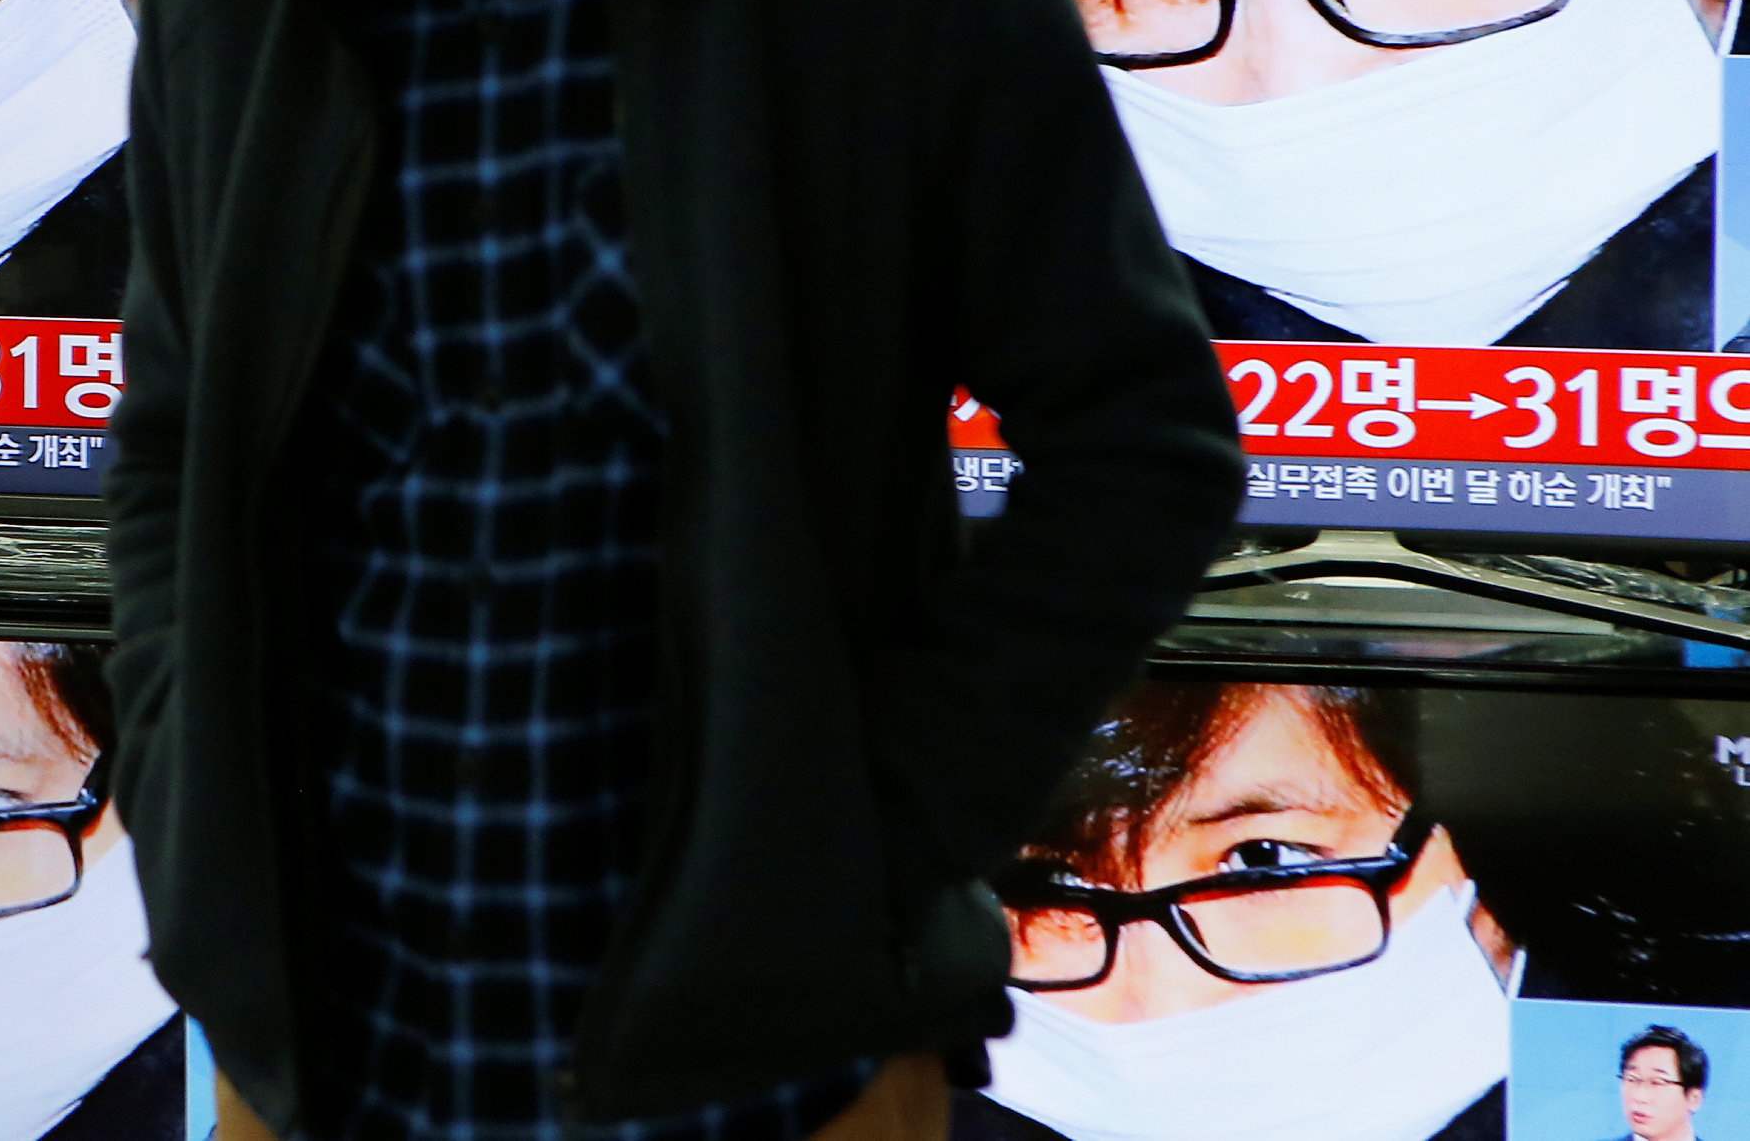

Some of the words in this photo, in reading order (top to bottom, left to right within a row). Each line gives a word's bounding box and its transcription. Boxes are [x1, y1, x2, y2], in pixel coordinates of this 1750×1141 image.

[1247, 462, 1377, 501] 실무접촉
[1387, 467, 1455, 503] 이번
[1465, 469, 1501, 504] 달
[1508, 471, 1578, 508] 하순
